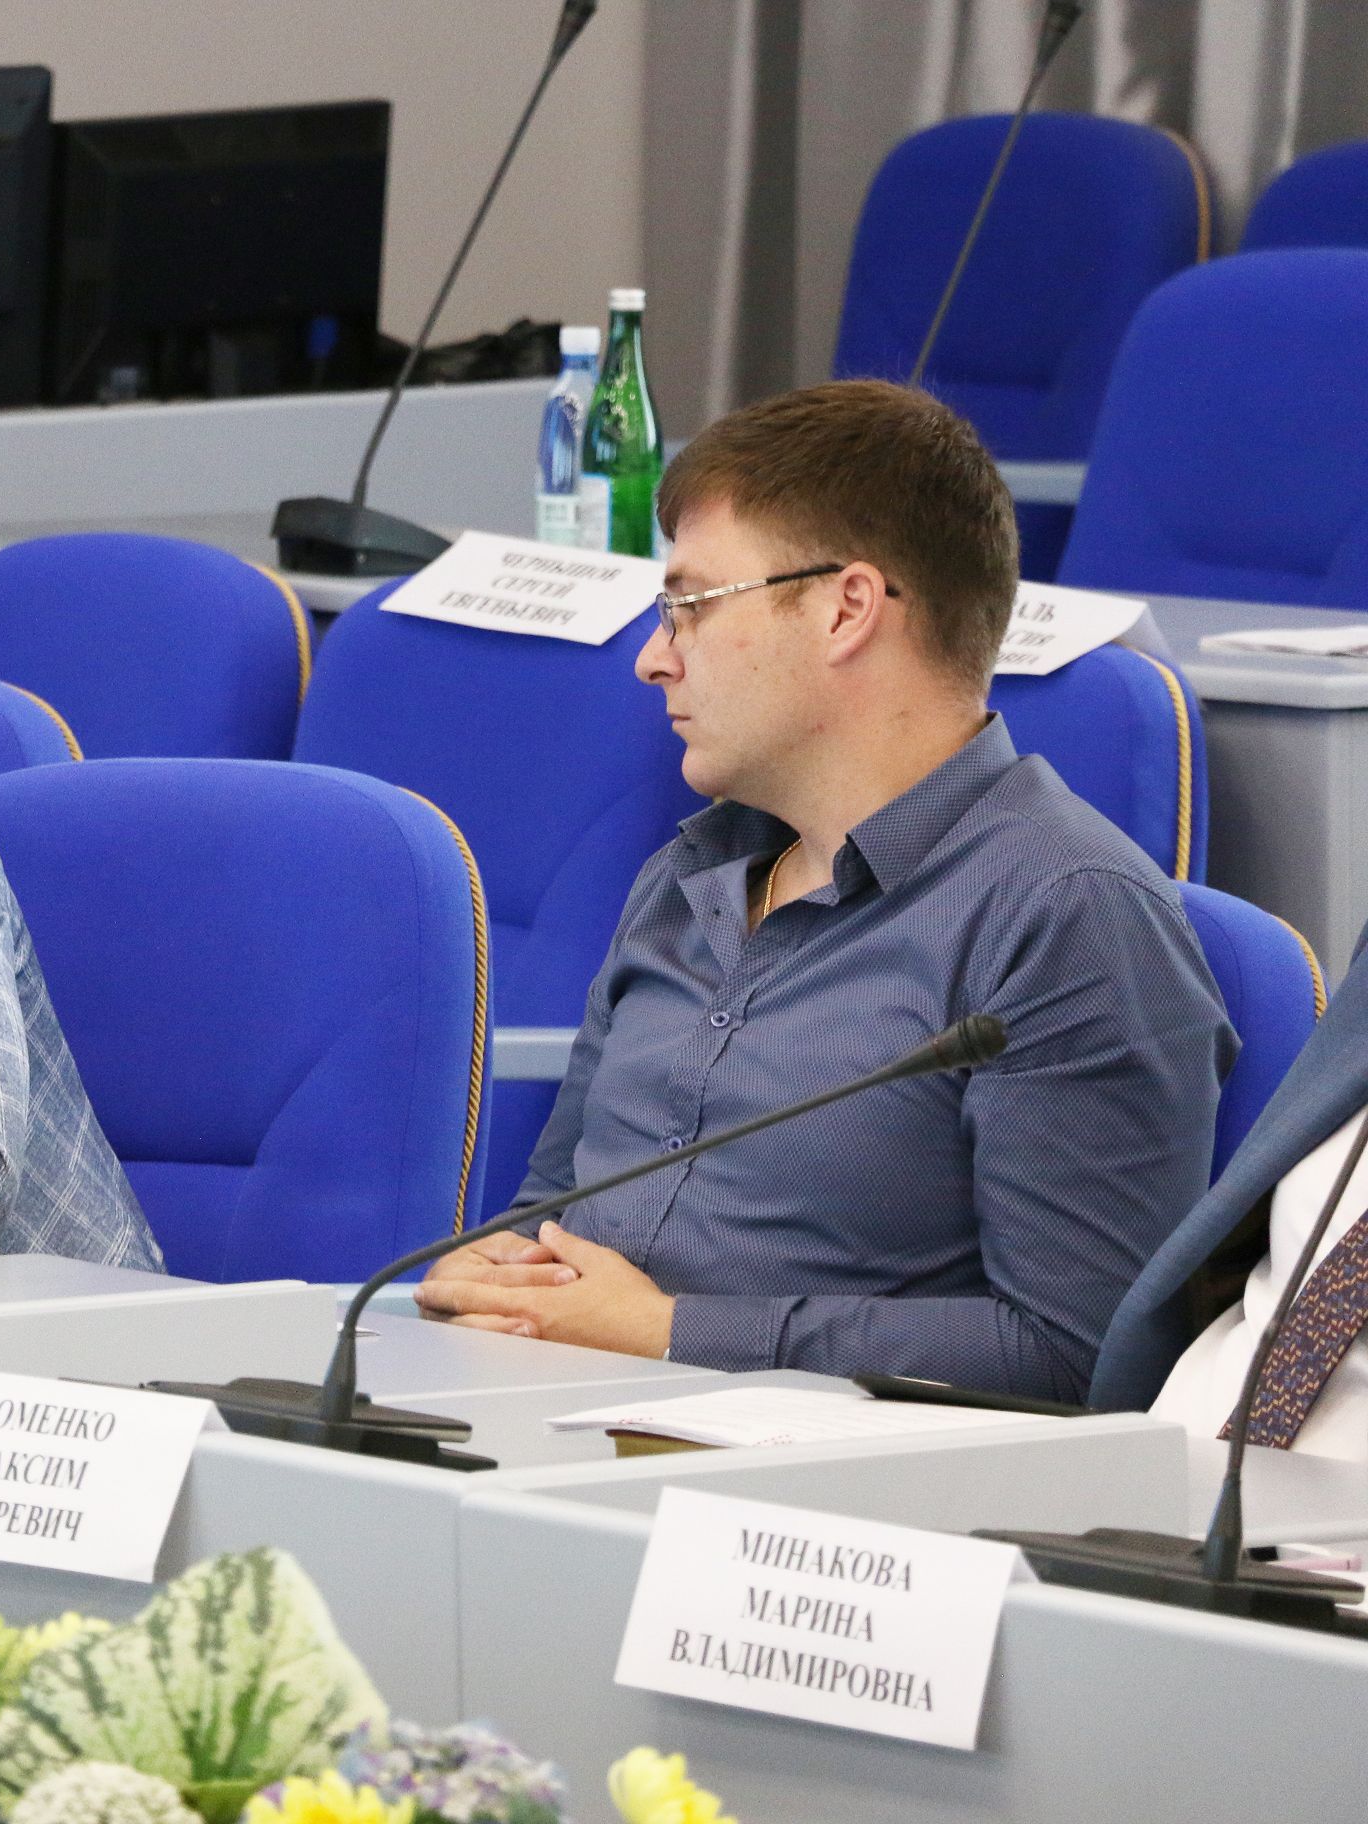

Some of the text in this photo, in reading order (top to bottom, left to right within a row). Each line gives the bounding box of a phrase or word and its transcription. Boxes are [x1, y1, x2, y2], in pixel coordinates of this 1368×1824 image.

[439, 591, 578, 625] ЕВГЕНЬЕВИЧ
[491, 574, 576, 599] СЕРГЕЙ
[731, 1528, 913, 1593] МИНАКОВА
[740, 1585, 875, 1643] МАРИНА
[668, 1628, 935, 1713] ВЛАДИМИРОВНА
